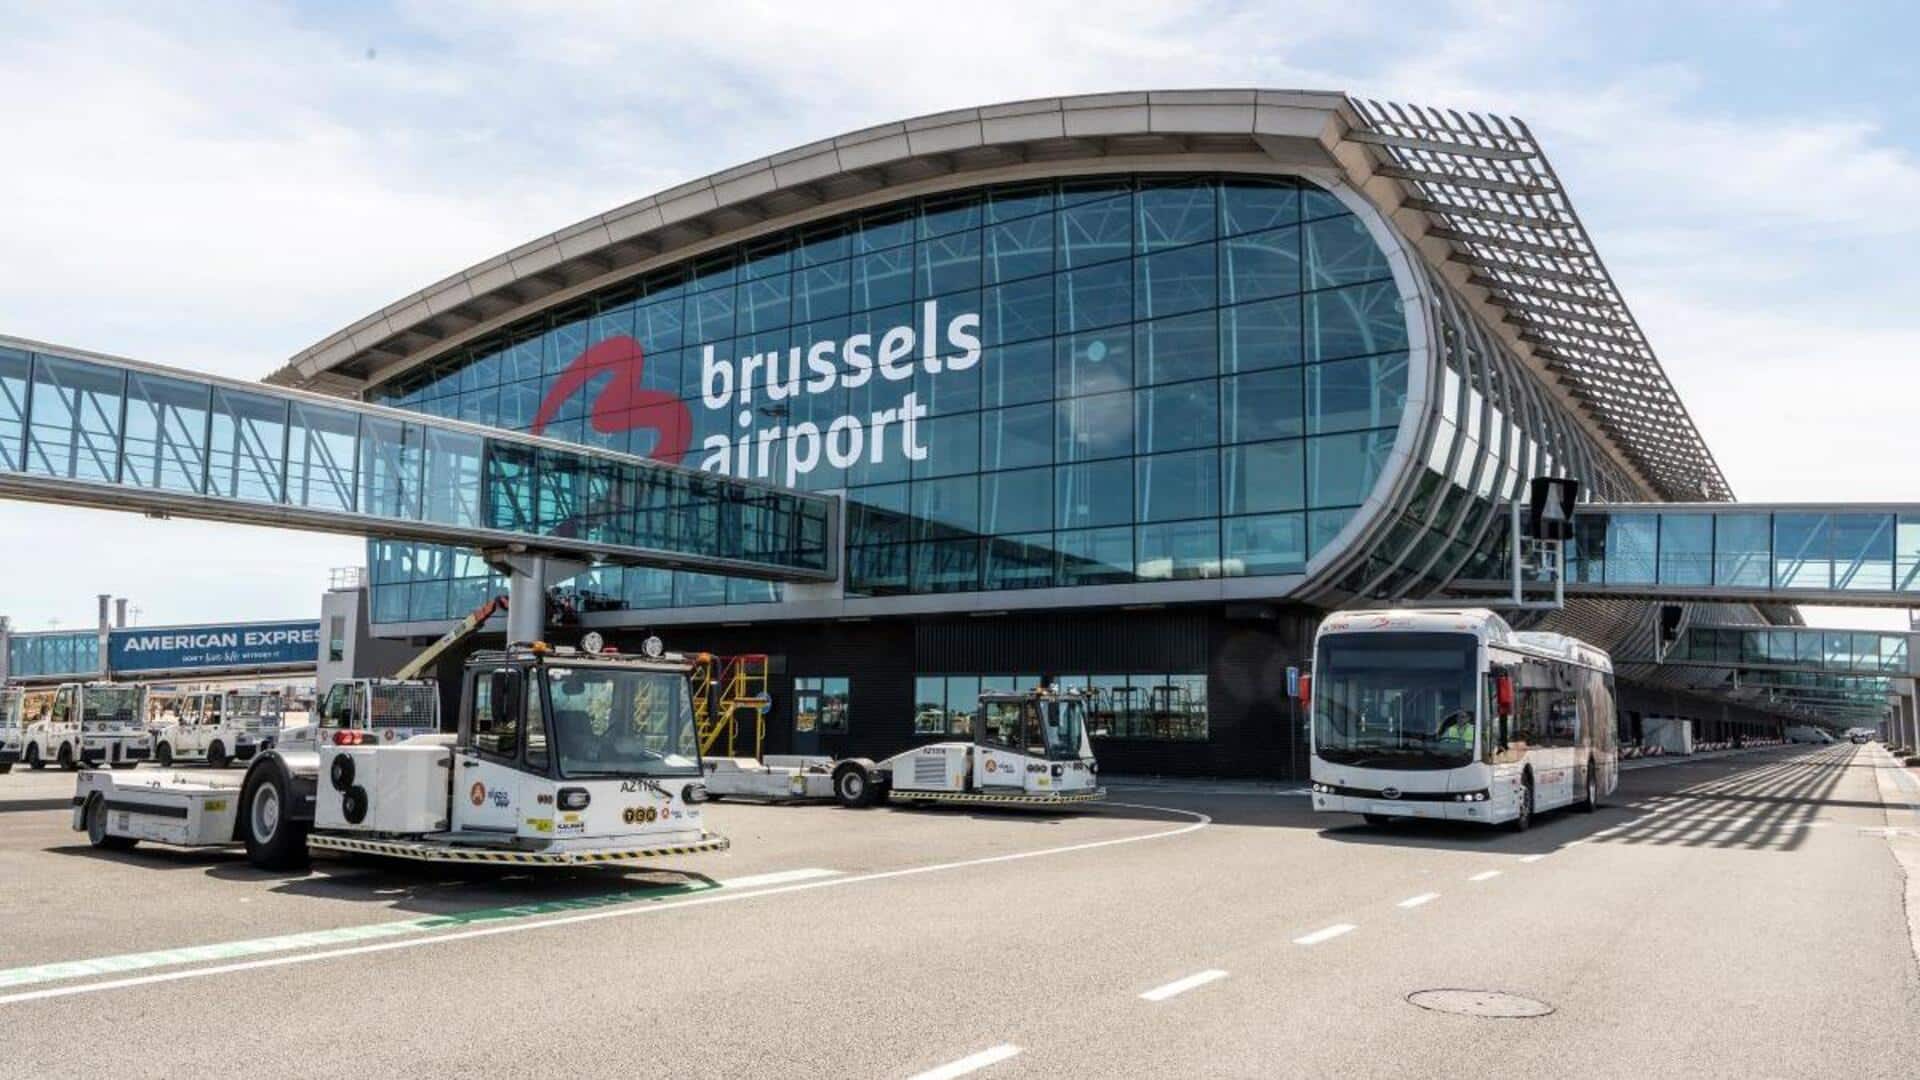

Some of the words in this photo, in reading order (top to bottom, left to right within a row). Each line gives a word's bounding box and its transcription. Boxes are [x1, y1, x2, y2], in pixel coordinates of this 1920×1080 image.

[701, 300, 982, 410] brussels
[700, 391, 928, 488] airport
[124, 633, 237, 652] AMERICAN
